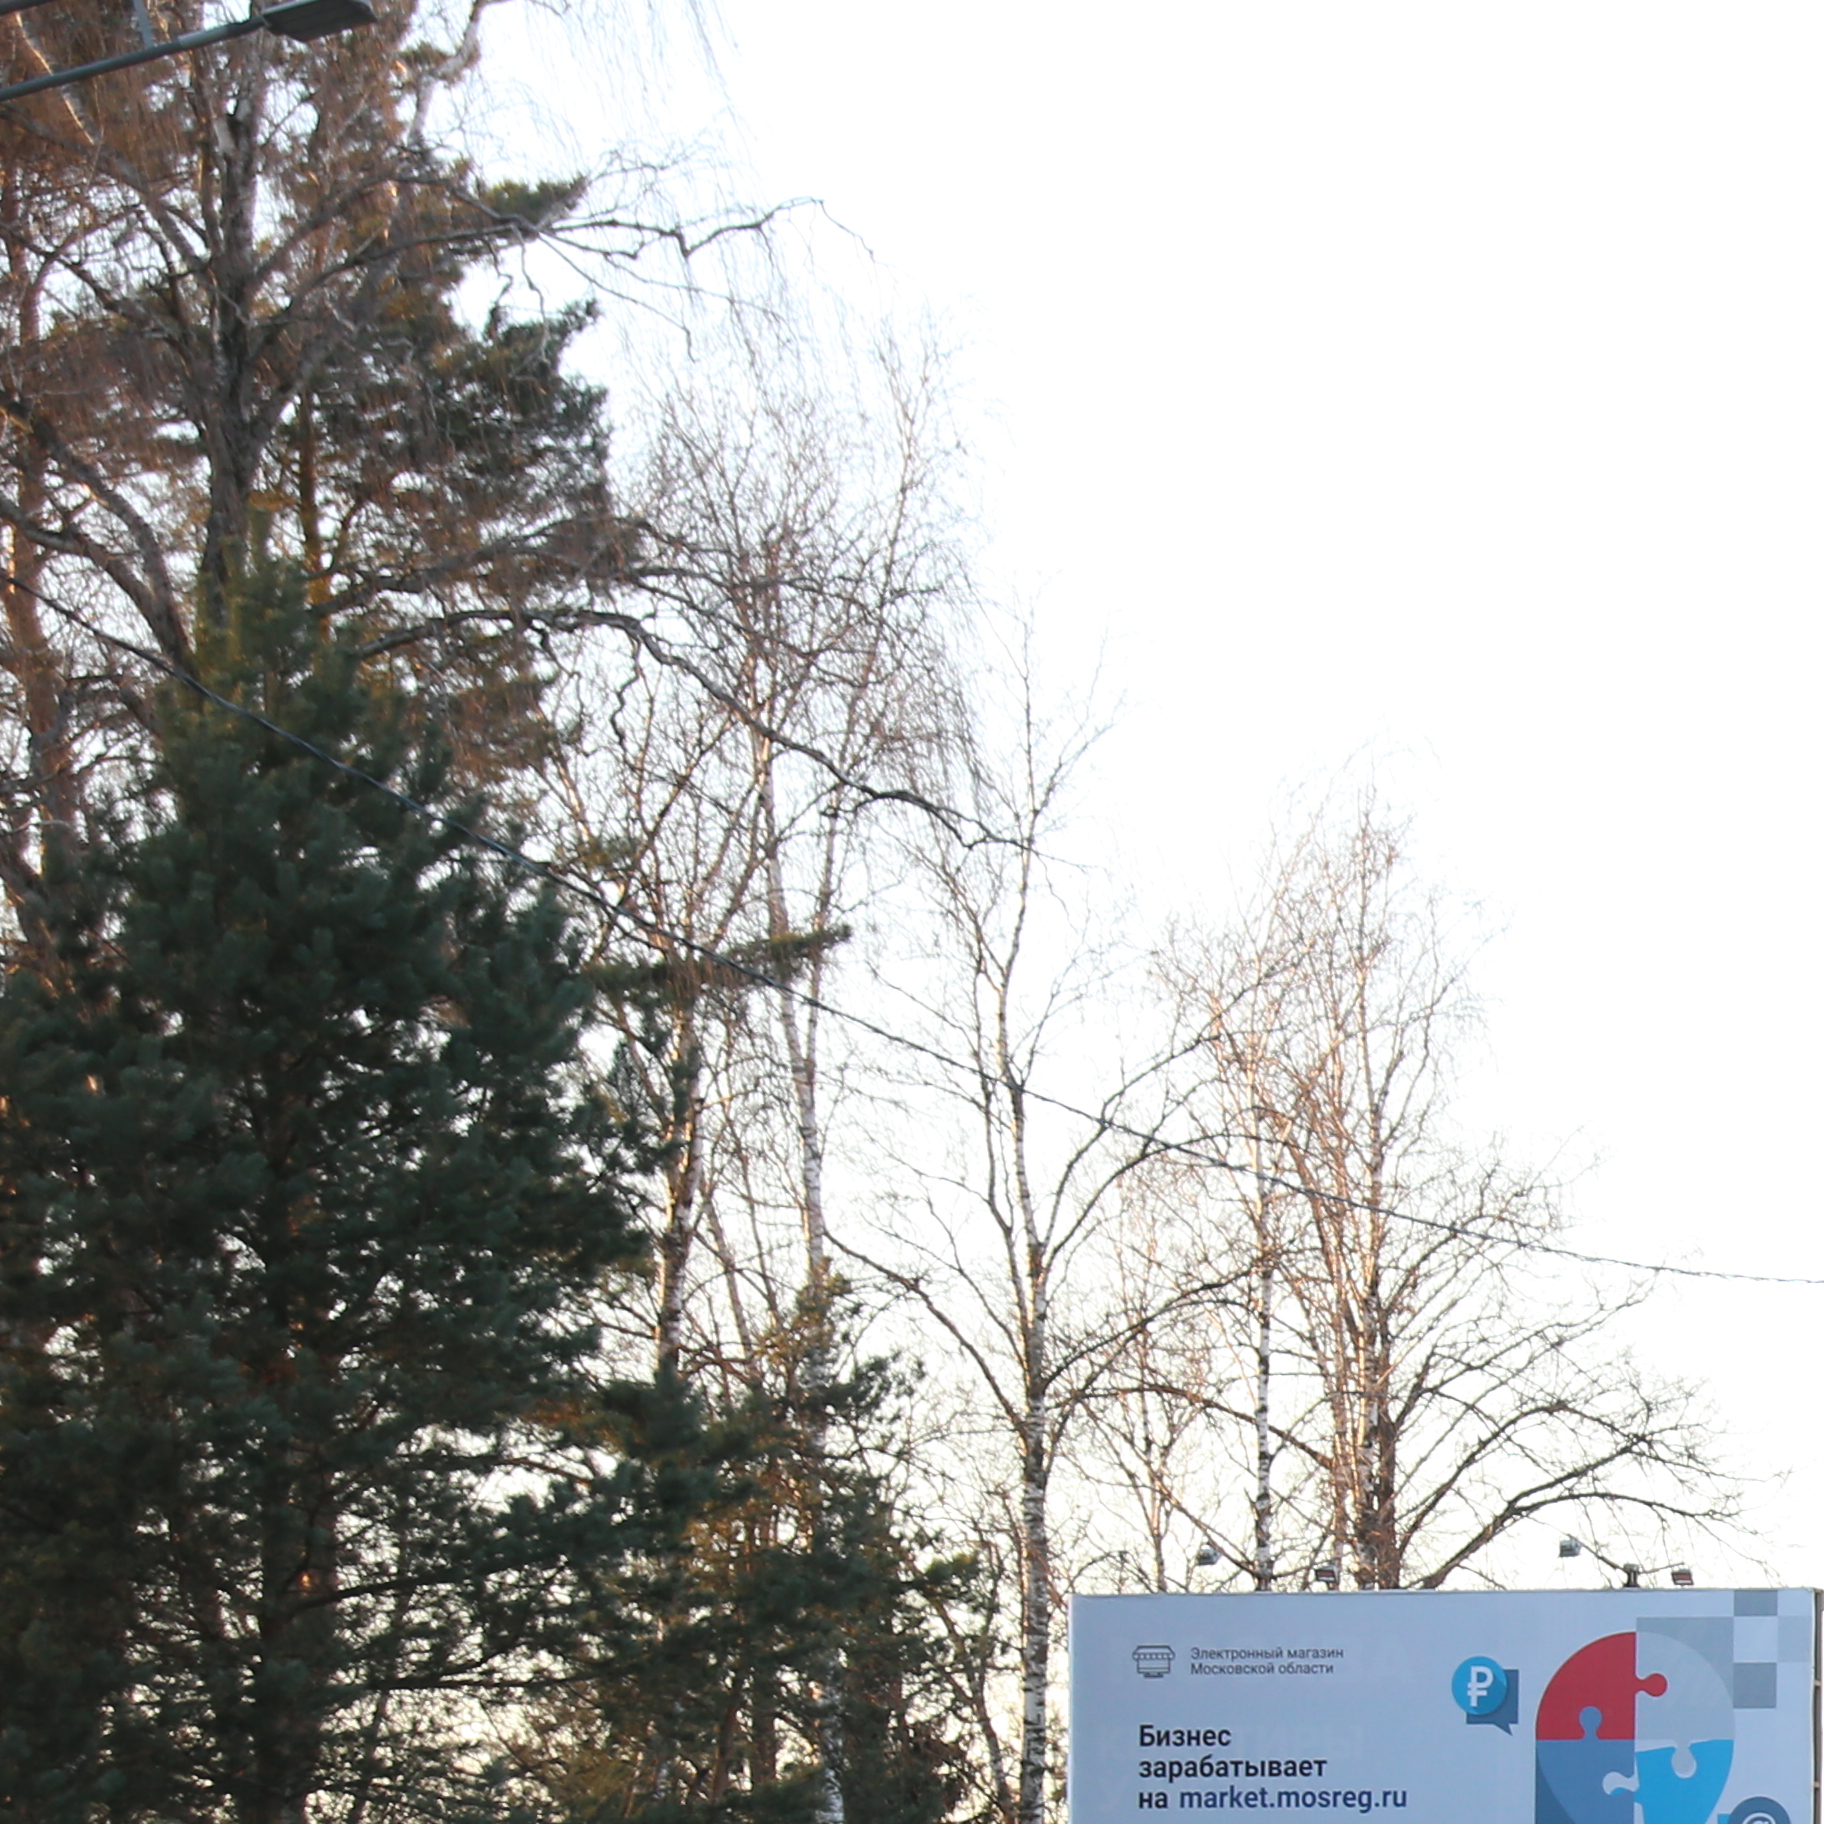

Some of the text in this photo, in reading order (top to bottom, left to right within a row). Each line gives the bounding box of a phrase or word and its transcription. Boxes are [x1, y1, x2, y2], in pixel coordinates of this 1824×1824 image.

[1190, 1647, 1344, 1661] Электронный магазин
[1190, 1661, 1334, 1675] Московской области
[1138, 1724, 1232, 1747] Бизнес
[1138, 1754, 1328, 1783] зарабатывает
[1138, 1785, 1407, 1814] на market.mosreg.ru
